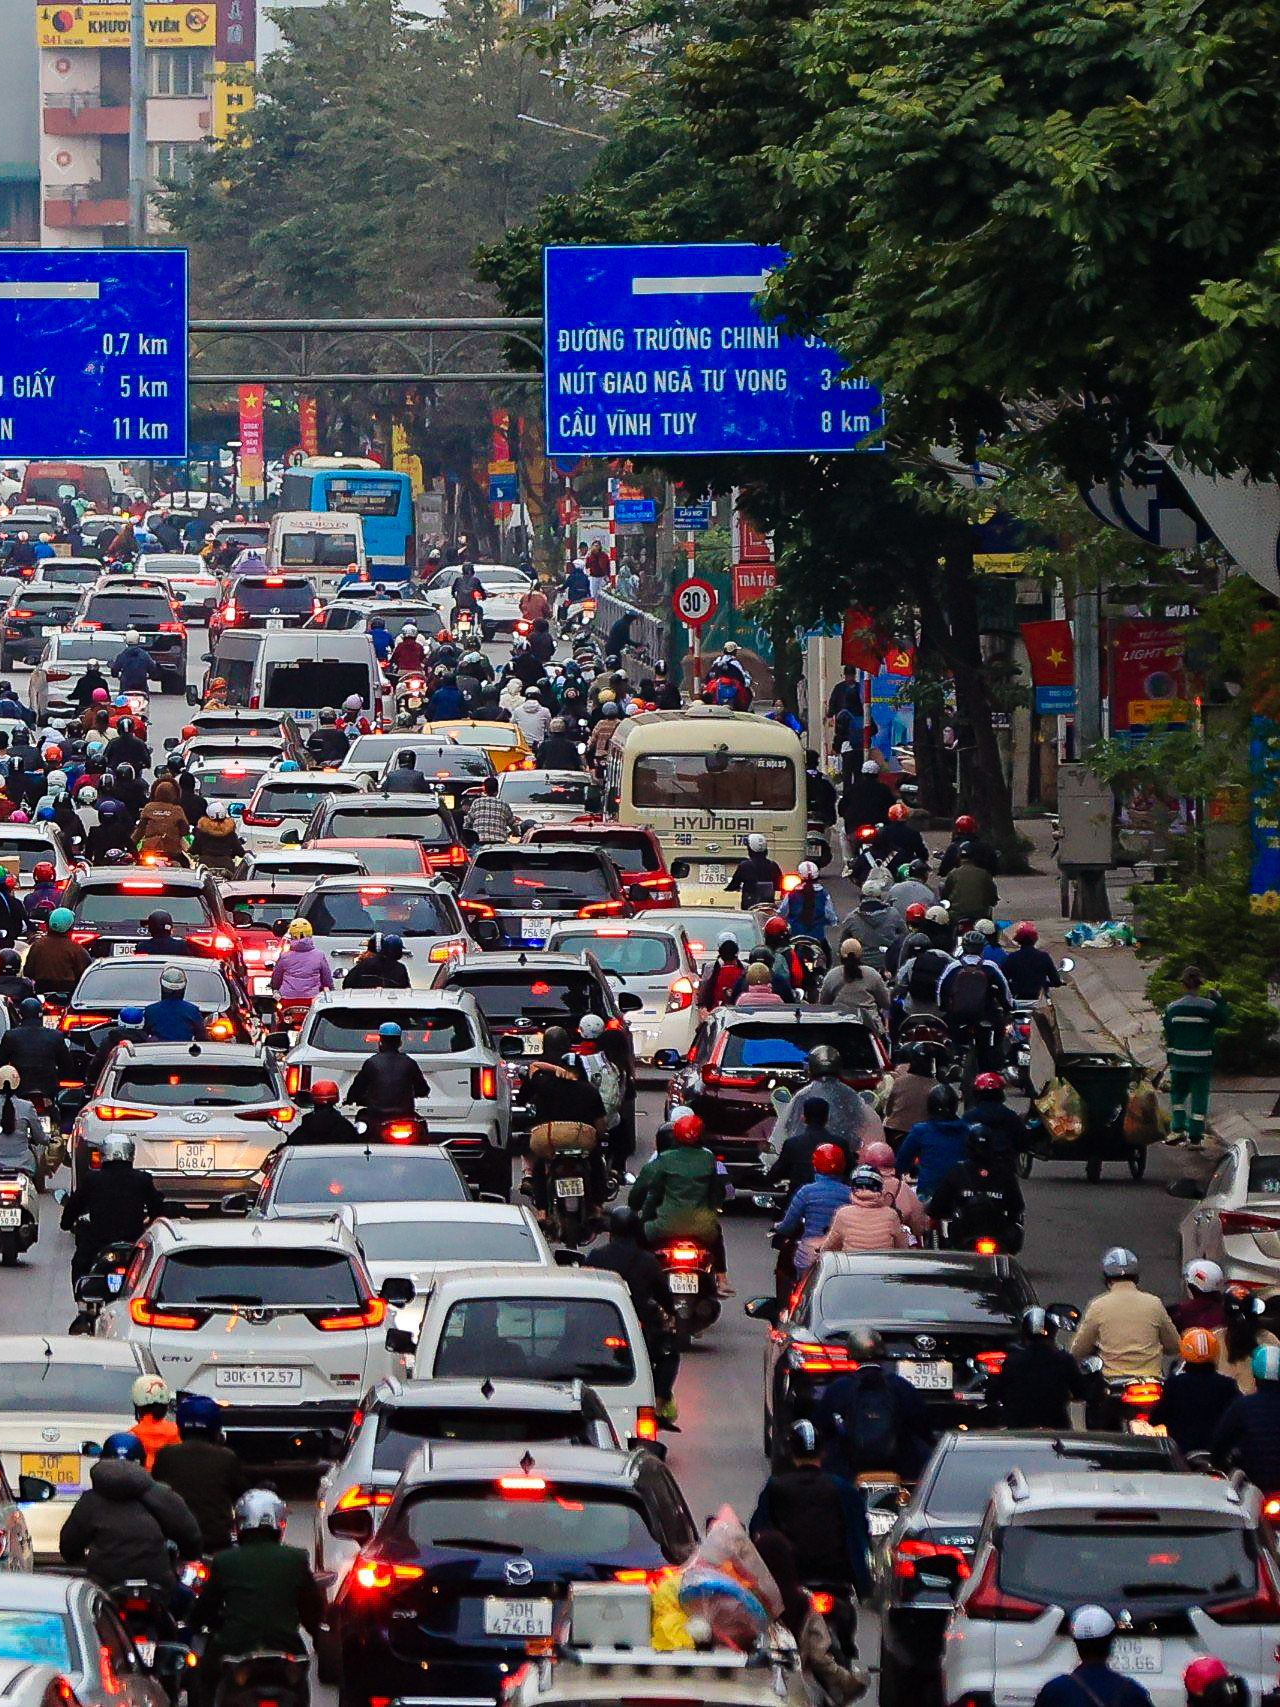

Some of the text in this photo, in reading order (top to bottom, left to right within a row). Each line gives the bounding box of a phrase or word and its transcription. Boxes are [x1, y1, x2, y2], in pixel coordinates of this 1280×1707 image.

[102, 332, 129, 356] 0,7
[138, 333, 168, 355] km
[558, 321, 624, 352] ĐƯỜNG
[633, 319, 711, 350] TRƯỜNG
[721, 326, 779, 349] CHINH
[13, 368, 56, 398] GIẤY
[120, 375, 131, 398] 5
[138, 375, 168, 397] km
[559, 363, 597, 394] NÚT
[603, 371, 647, 394] GIAO
[654, 365, 693, 393] NGÃ
[701, 367, 726, 392] TƯ
[735, 368, 787, 396] VỌNG
[820, 368, 831, 391] 3
[113, 418, 130, 440] 11
[138, 418, 169, 440] km
[559, 406, 870, 437] CẦU VĨNH TUY 8 km
[673, 817, 754, 830] HYUNDAI
[186, 1145, 206, 1156] 30F
[223, 1371, 294, 1383] 30K-112.57
